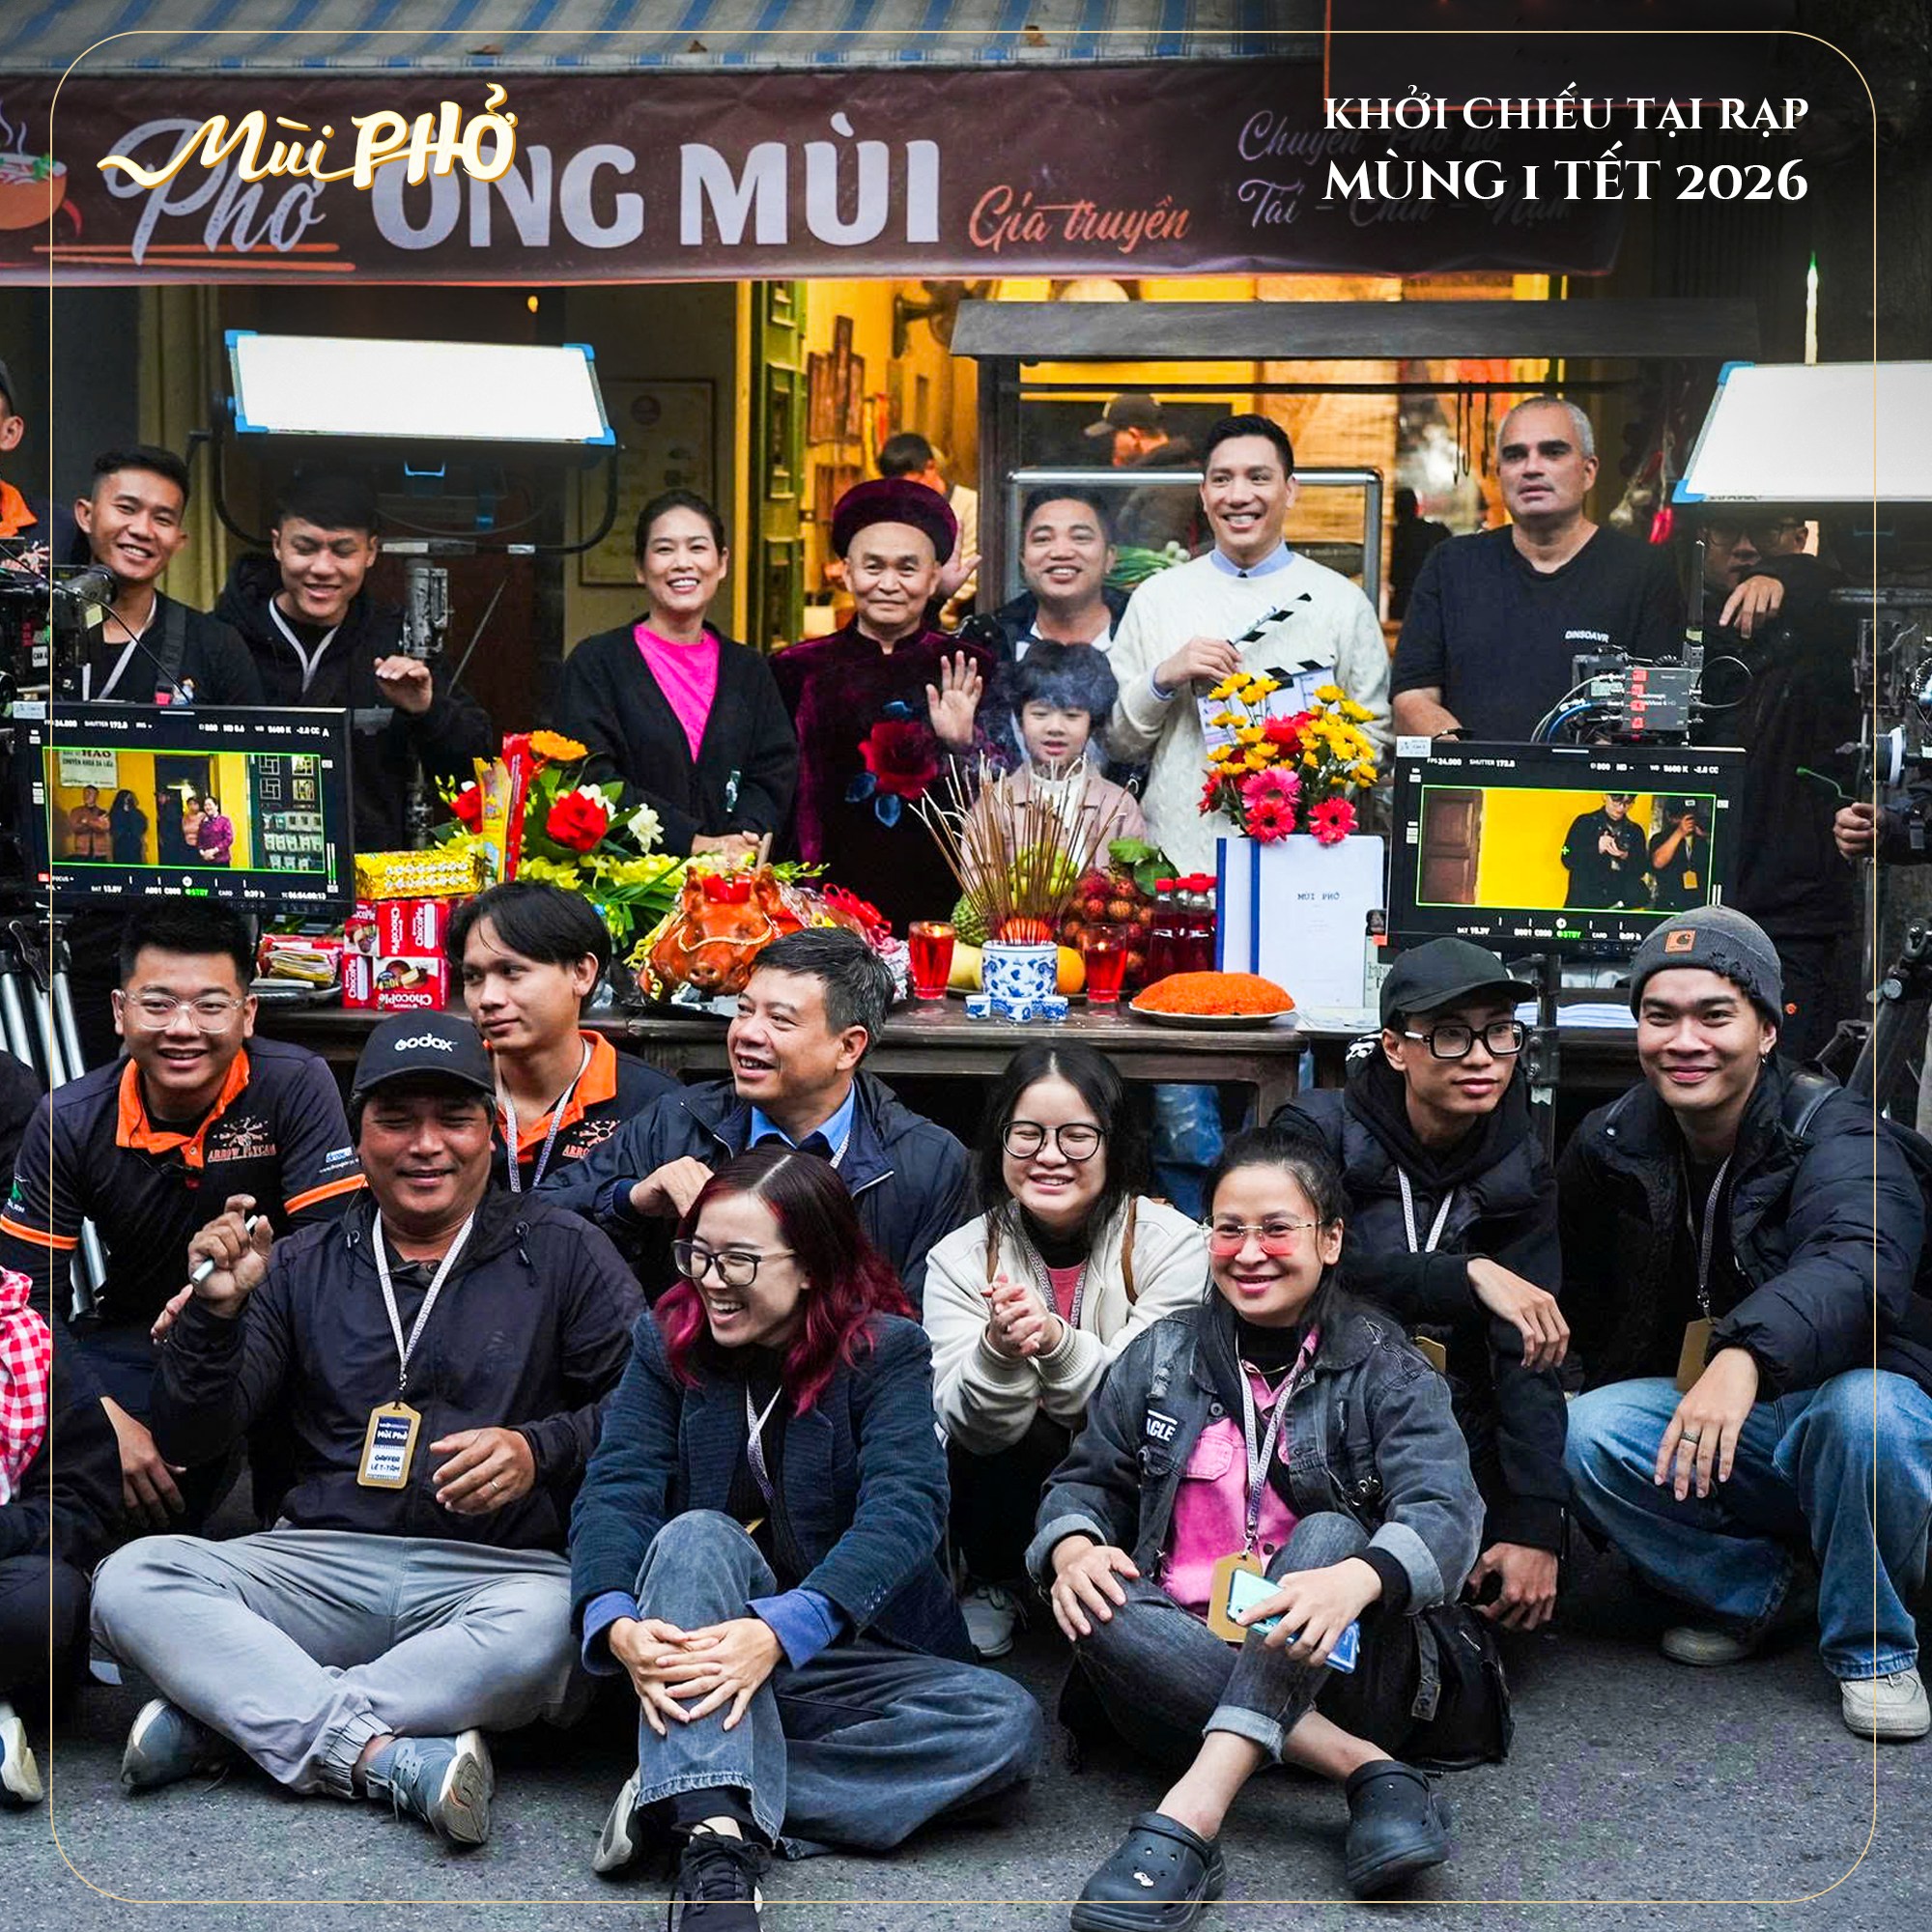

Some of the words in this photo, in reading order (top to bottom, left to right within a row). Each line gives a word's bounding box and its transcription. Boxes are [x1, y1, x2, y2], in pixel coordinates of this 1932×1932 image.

[679, 111, 939, 246] MÙI
[1036, 195, 1190, 254] truyền
[390, 907, 401, 954] ChocoPie
[378, 993, 434, 1006] ChocoPie
